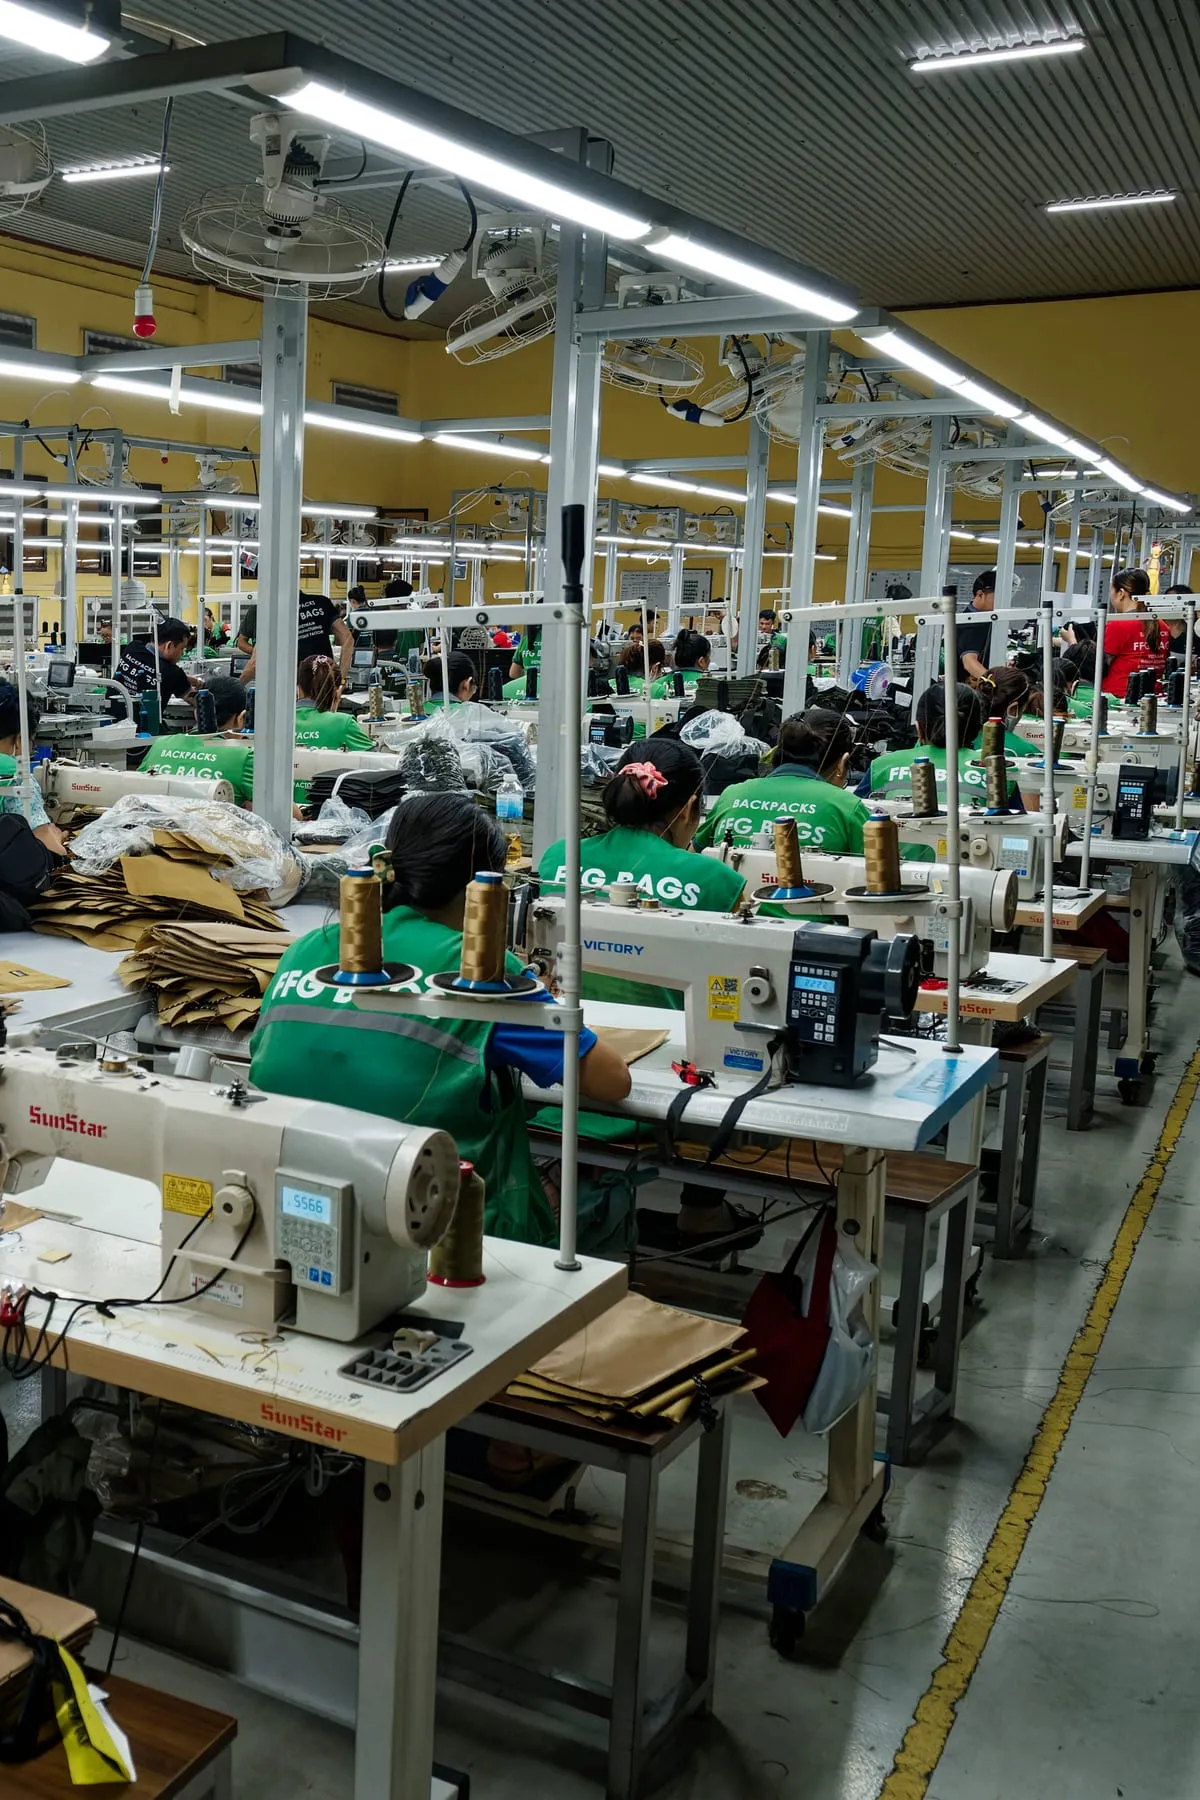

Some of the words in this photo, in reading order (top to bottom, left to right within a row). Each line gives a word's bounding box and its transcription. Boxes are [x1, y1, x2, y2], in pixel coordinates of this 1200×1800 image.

[300, 608, 324, 620] BAGS
[161, 750, 217, 762] BACKPACKS
[889, 767, 913, 781] FF
[71, 782, 101, 793] SunStar
[732, 799, 816, 814] BACKPACKS
[760, 819, 826, 844] BGS
[555, 865, 607, 888] FG
[584, 940, 644, 956] VICTORY
[943, 1001, 996, 1015] SnStar
[730, 1049, 759, 1058] VICTORY
[29, 1105, 108, 1139] SunStar
[293, 1194, 323, 1214] 5566
[261, 1402, 348, 1442] SunStar
